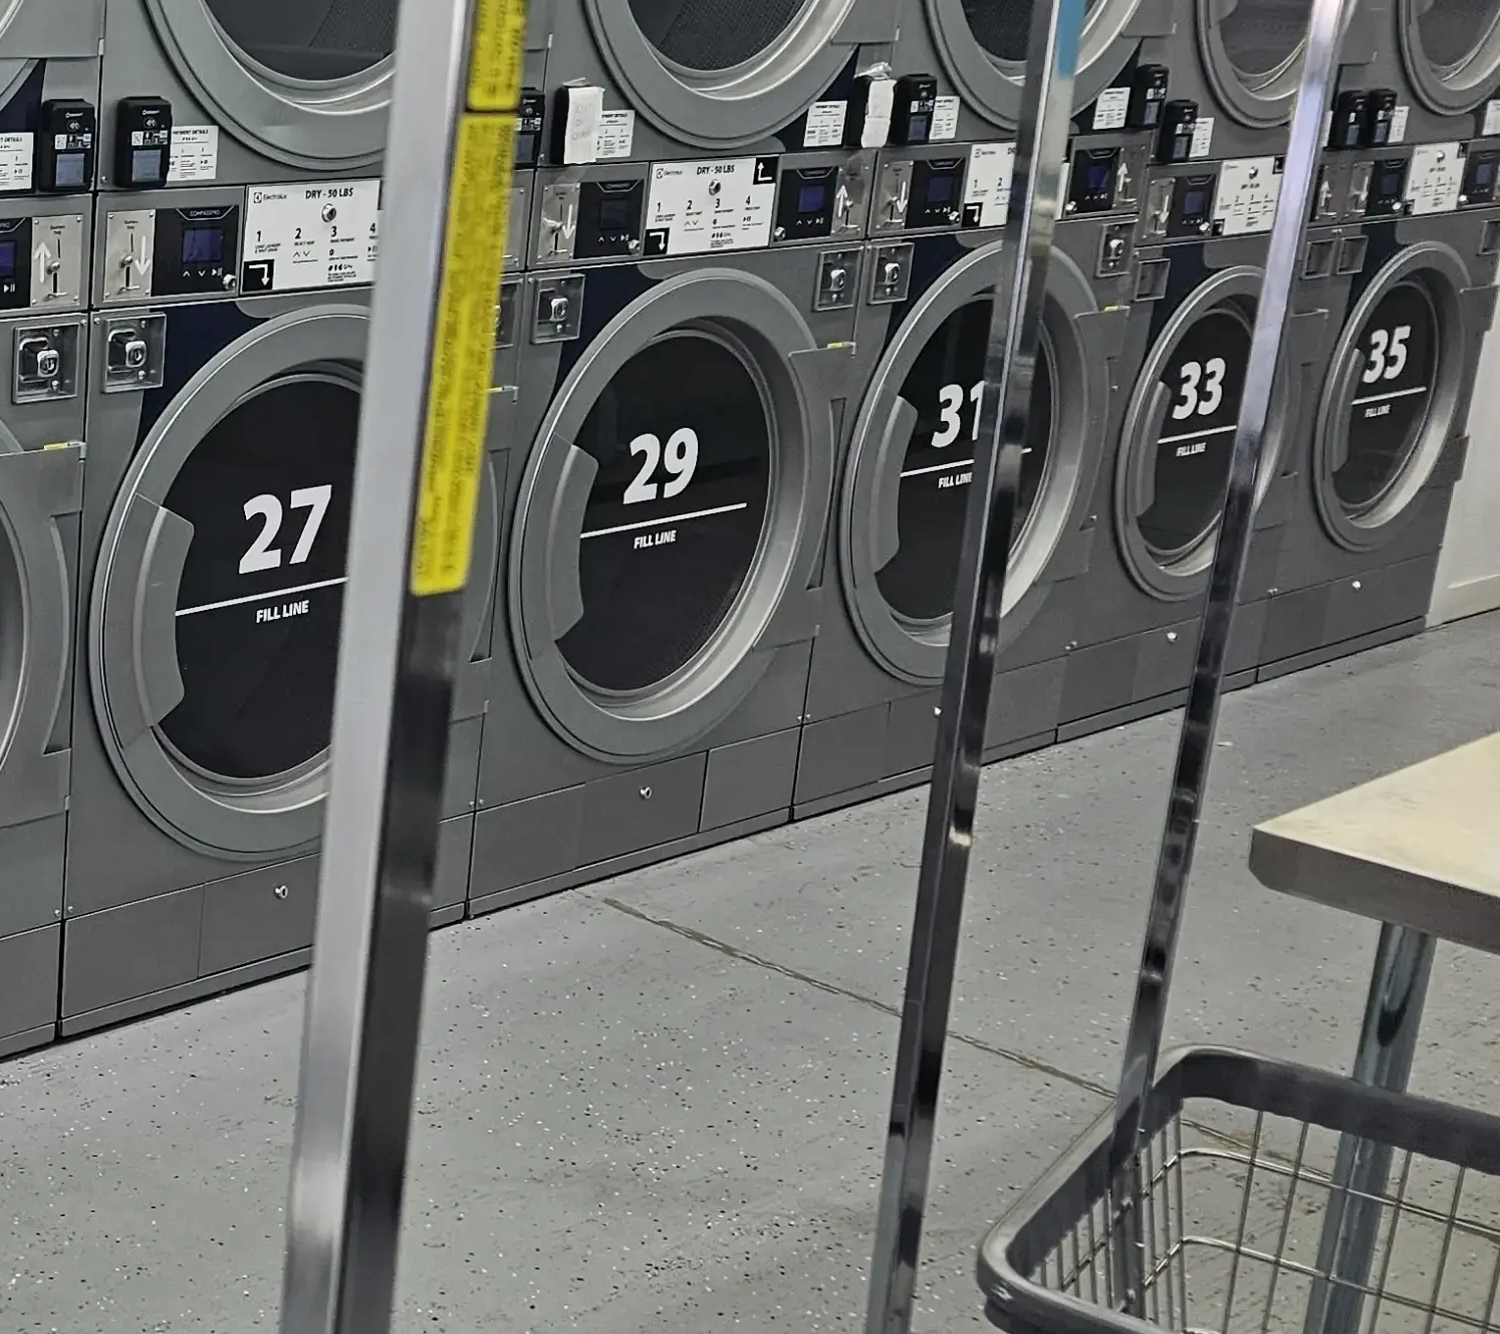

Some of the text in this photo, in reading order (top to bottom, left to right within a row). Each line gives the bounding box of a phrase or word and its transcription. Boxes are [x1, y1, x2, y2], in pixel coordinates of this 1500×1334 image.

[696, 166, 709, 175] DRY
[714, 166, 722, 174] 50
[722, 164, 735, 173] LBS
[305, 190, 322, 199] DRY
[327, 189, 338, 198] 50
[339, 187, 354, 197] LBS
[657, 195, 751, 212] 1 2 3 4
[256, 222, 376, 242] 1 2 3 4
[1362, 325, 1411, 384] 35
[1172, 357, 1226, 420] 33
[931, 380, 985, 448] 31
[623, 427, 698, 505] 29
[938, 472, 972, 488] FILL LINE
[238, 484, 332, 575] 27
[633, 530, 677, 549] FILL LINE
[256, 600, 309, 623] FILL LINE
